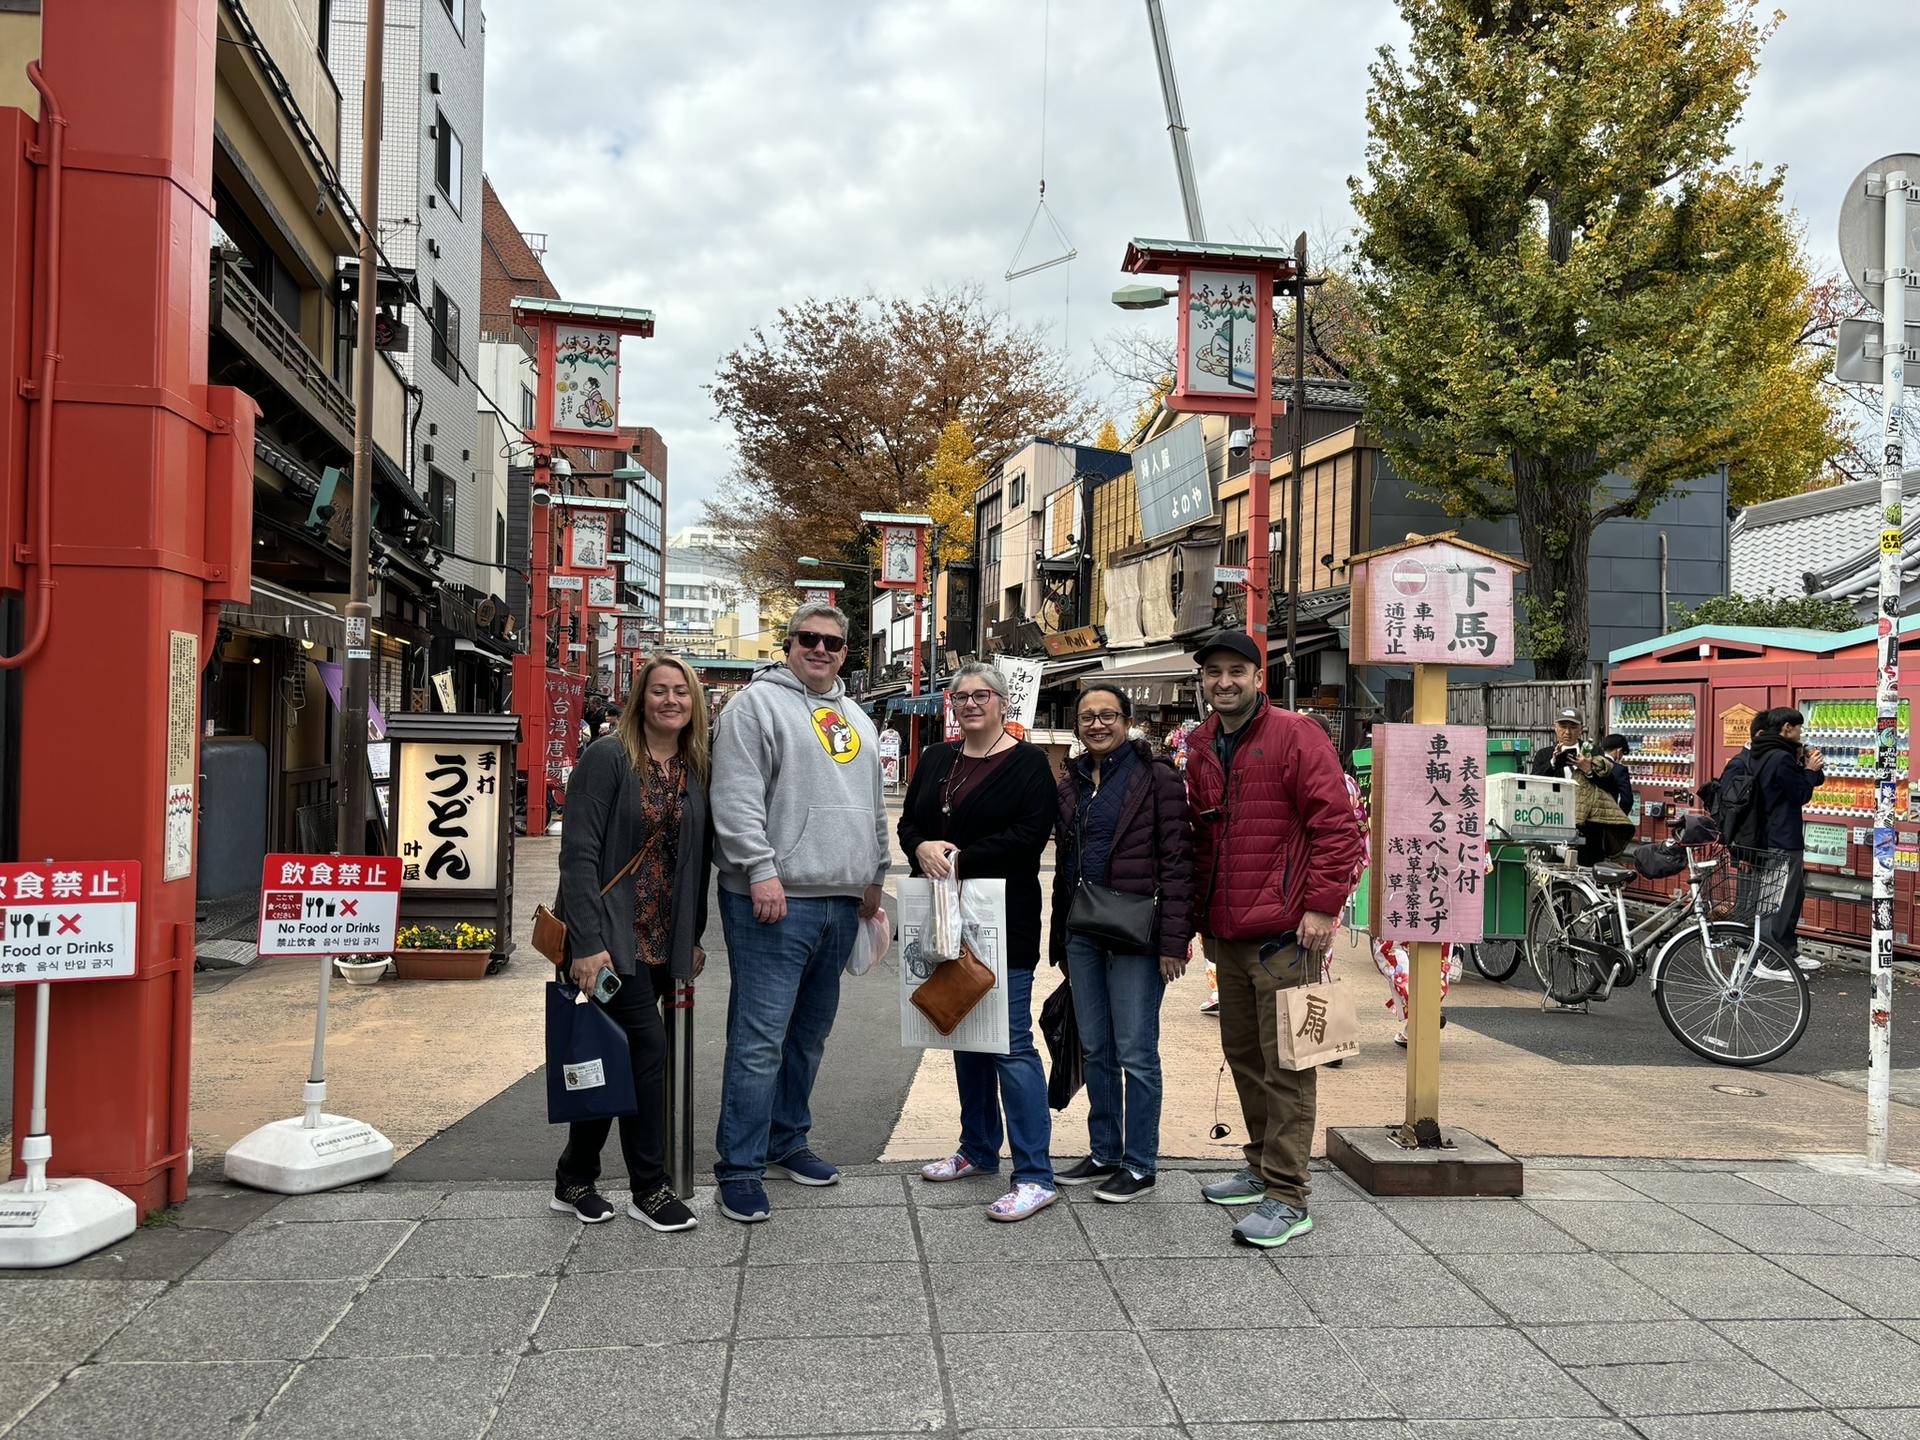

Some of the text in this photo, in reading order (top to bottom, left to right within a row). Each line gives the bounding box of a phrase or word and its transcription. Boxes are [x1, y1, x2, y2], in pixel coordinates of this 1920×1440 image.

[1171, 486, 1202, 519] よのや
[1384, 602, 1407, 655] 通行止
[1446, 566, 1498, 658] 下馬
[1007, 671, 1034, 720] わらび餅
[477, 751, 497, 794] 手打
[424, 754, 474, 880] うどん
[1455, 755, 1482, 895] 表参道に付
[280, 861, 387, 886] 飲食禁止
[403, 840, 422, 881] 叶屋
[1386, 837, 1404, 929] 浅草寺
[1405, 837, 1423, 929] 浅草警察署
[2, 941, 114, 957] Food or Drinks
[278, 922, 380, 934] No Food or Drinks
[363, 937, 380, 946] 금지
[36, 958, 114, 972] 음식 반입 금지
[1296, 994, 1328, 1045] 扇
